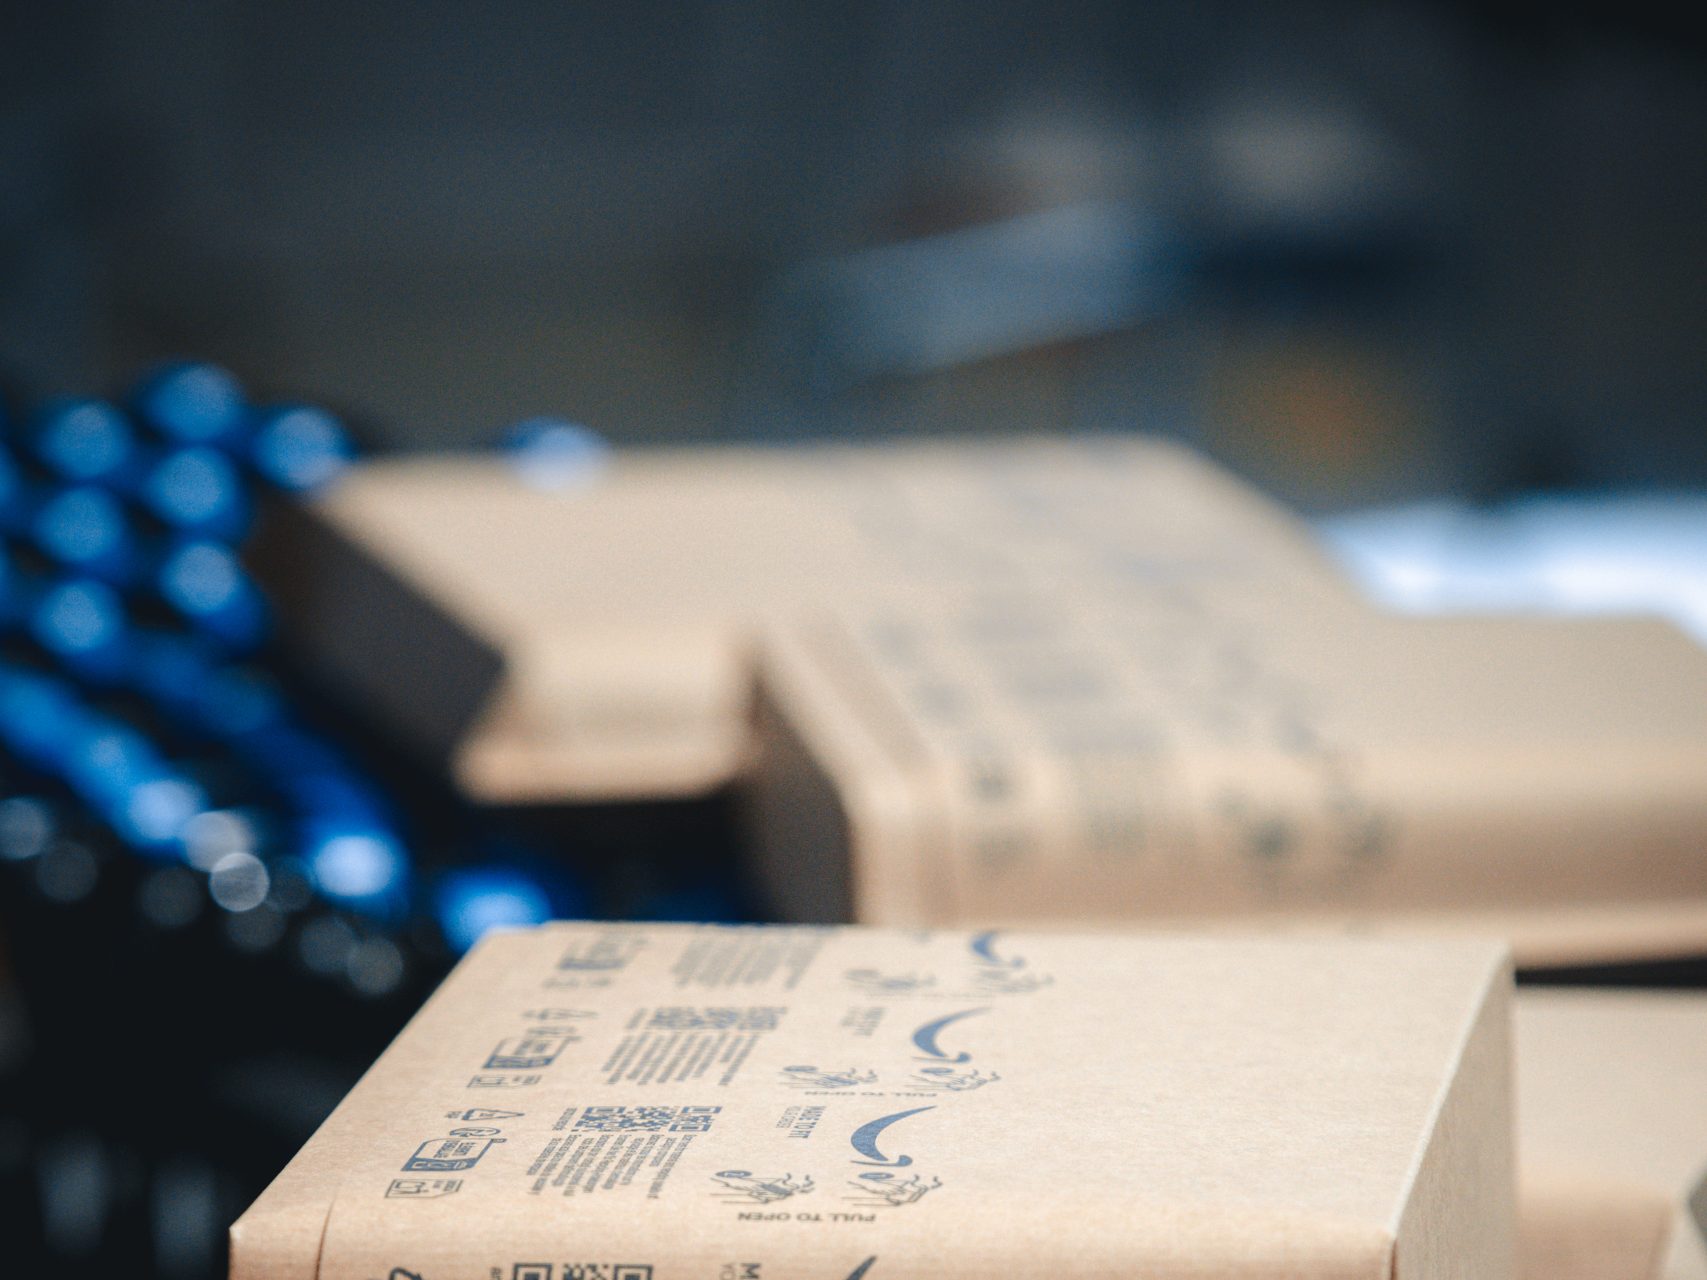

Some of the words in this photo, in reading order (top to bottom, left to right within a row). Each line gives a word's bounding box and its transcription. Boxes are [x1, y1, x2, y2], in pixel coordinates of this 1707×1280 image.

[737, 1212, 791, 1222] OPEN
[796, 1213, 823, 1222] TO
[830, 1213, 876, 1223] PULL
